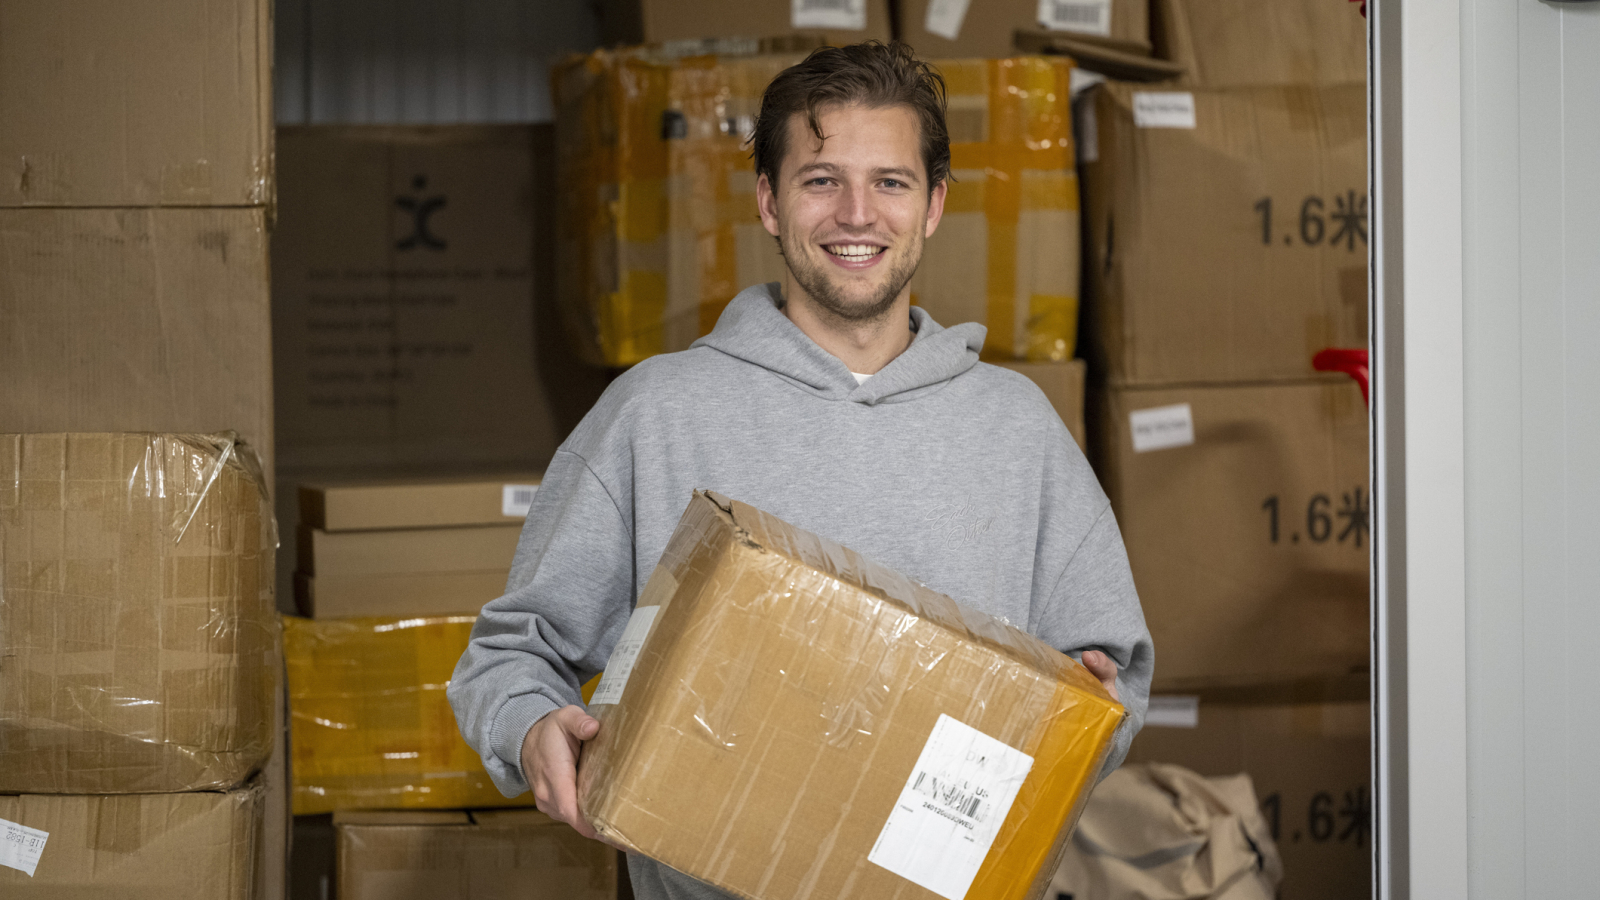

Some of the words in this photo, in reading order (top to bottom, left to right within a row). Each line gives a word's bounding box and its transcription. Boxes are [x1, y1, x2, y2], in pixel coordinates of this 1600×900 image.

[1254, 190, 1368, 252] 1.6米
[1262, 487, 1370, 547] 1.6米
[6, 831, 44, 849] 11B-1582
